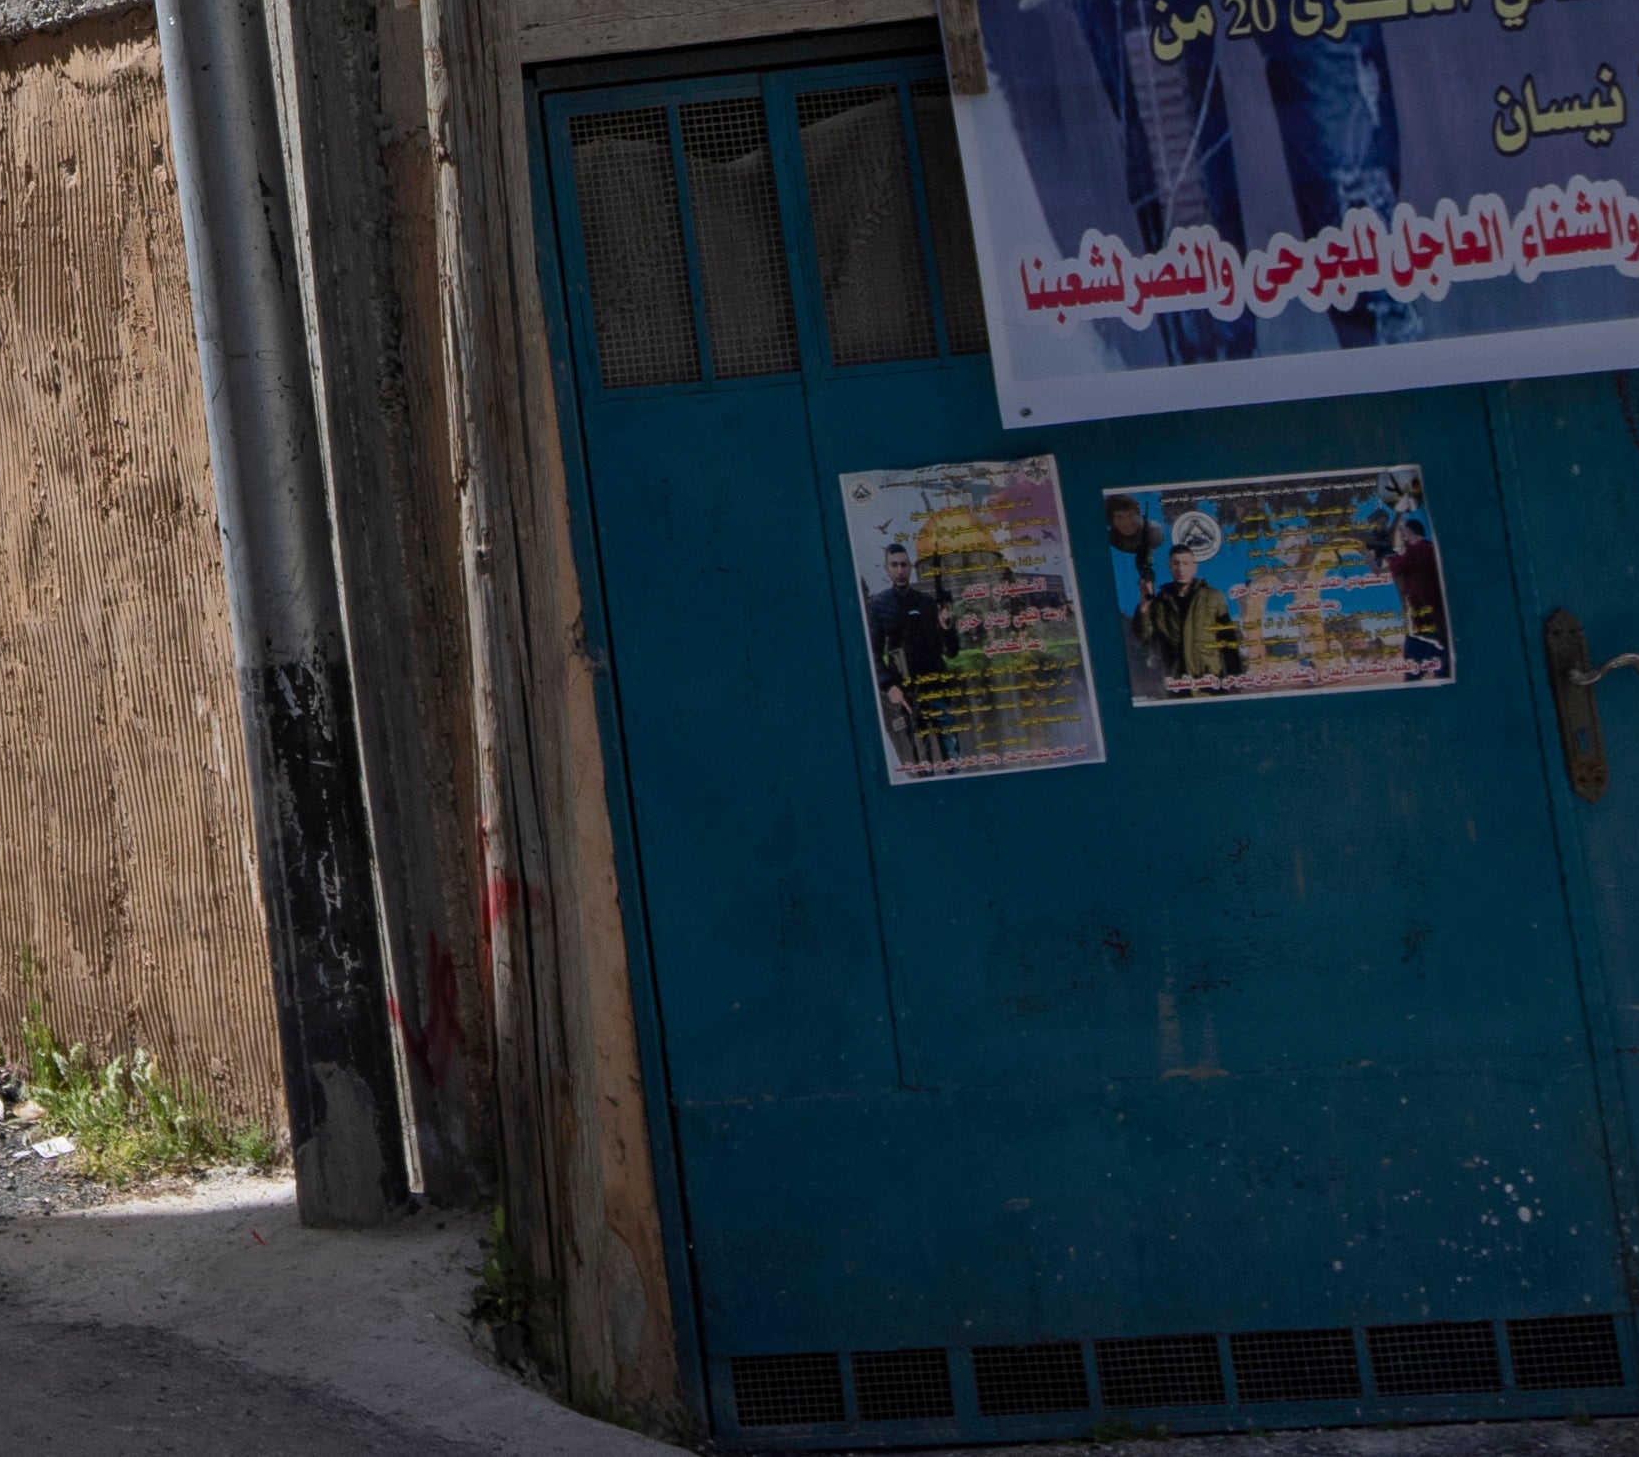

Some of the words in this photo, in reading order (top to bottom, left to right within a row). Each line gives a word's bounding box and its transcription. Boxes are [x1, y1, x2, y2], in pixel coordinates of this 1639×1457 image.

[1494, 63, 1625, 155] نيسان
[1020, 243, 1124, 324] لشعبنا
[1127, 238, 1235, 316] والنصر
[1250, 222, 1381, 303] للجرحى
[1390, 210, 1505, 288] العاجل
